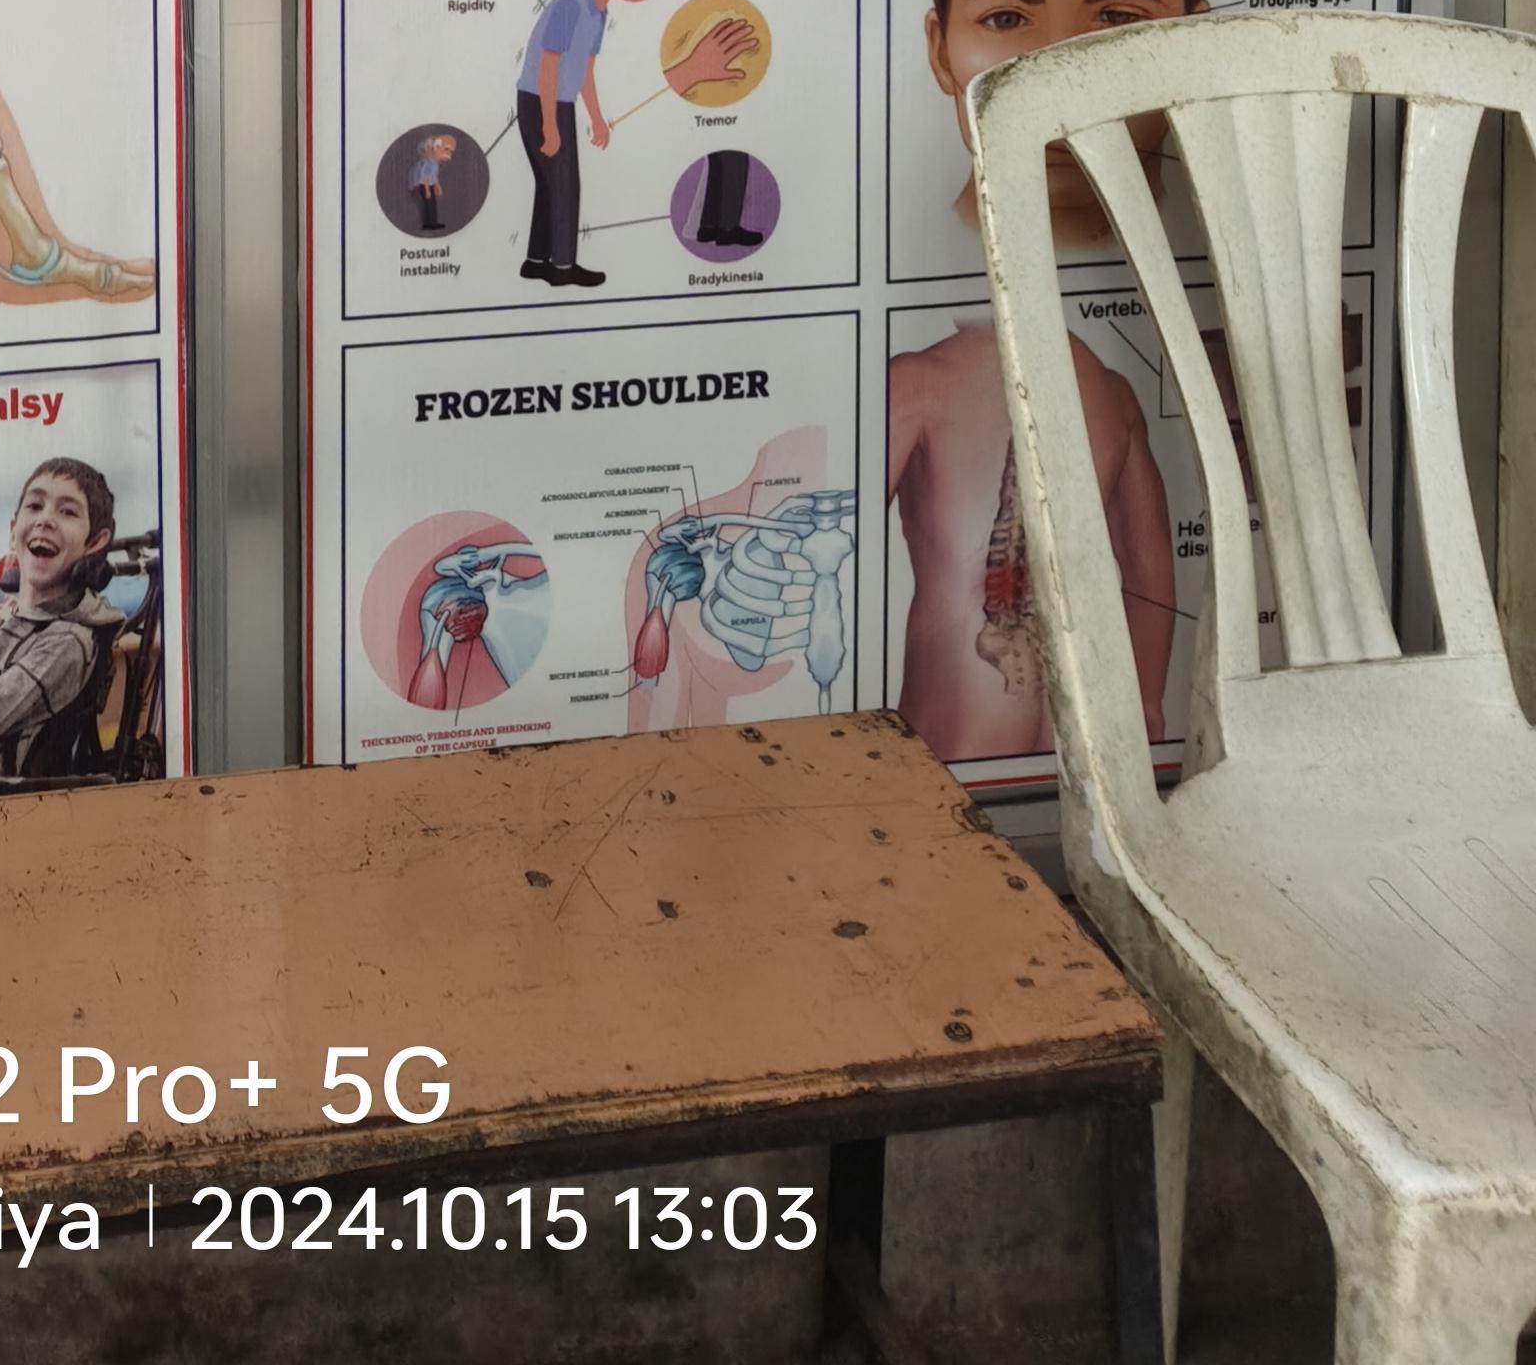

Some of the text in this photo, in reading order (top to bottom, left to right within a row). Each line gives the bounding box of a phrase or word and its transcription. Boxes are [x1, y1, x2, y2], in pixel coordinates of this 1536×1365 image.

[695, 114, 738, 128] Tremor
[400, 245, 451, 261] Postural
[399, 261, 462, 279] instability
[688, 270, 765, 287] Bradykinesia
[1079, 299, 1148, 319] Verteb
[415, 369, 771, 423] FROZEN SHOULDER
[473, 727, 496, 737] AND
[415, 738, 497, 755] OF THE CAPSULE
